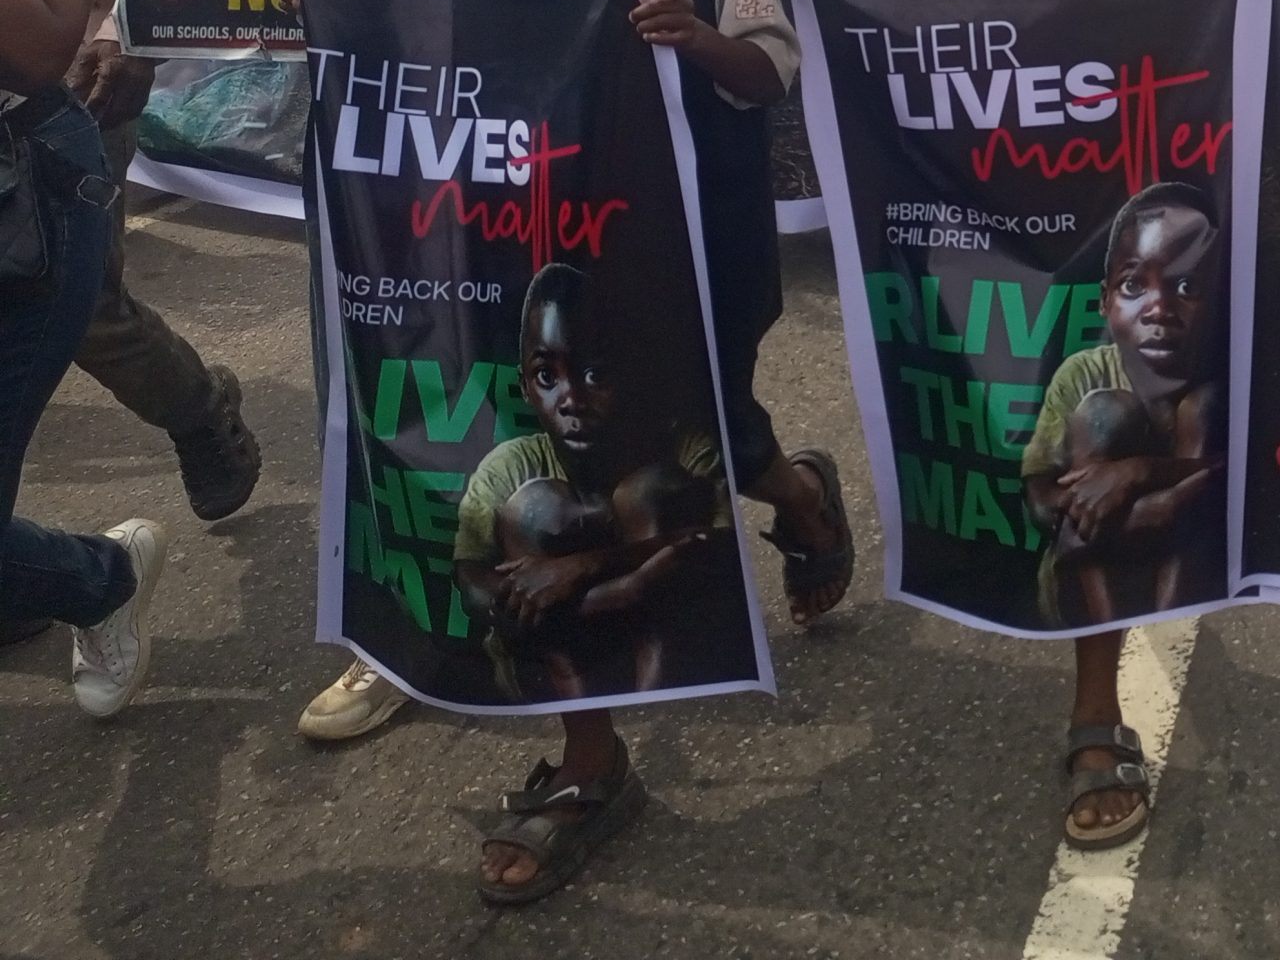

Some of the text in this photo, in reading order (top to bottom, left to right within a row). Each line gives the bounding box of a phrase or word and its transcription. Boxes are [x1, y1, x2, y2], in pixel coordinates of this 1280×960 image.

[152, 24, 305, 41] OUR SCHOOLS, OUR CHILDR
[844, 20, 1021, 74] THEIR
[306, 46, 483, 118] THEIR
[887, 62, 1119, 130] LIVES
[332, 104, 531, 186] LIVES
[971, 55, 1233, 196] matter
[411, 119, 629, 274] matter
[886, 203, 1076, 235] #BRING BACK OUR
[886, 227, 991, 251] CHILDREN
[377, 277, 452, 301] BACK
[458, 281, 503, 303] OUR
